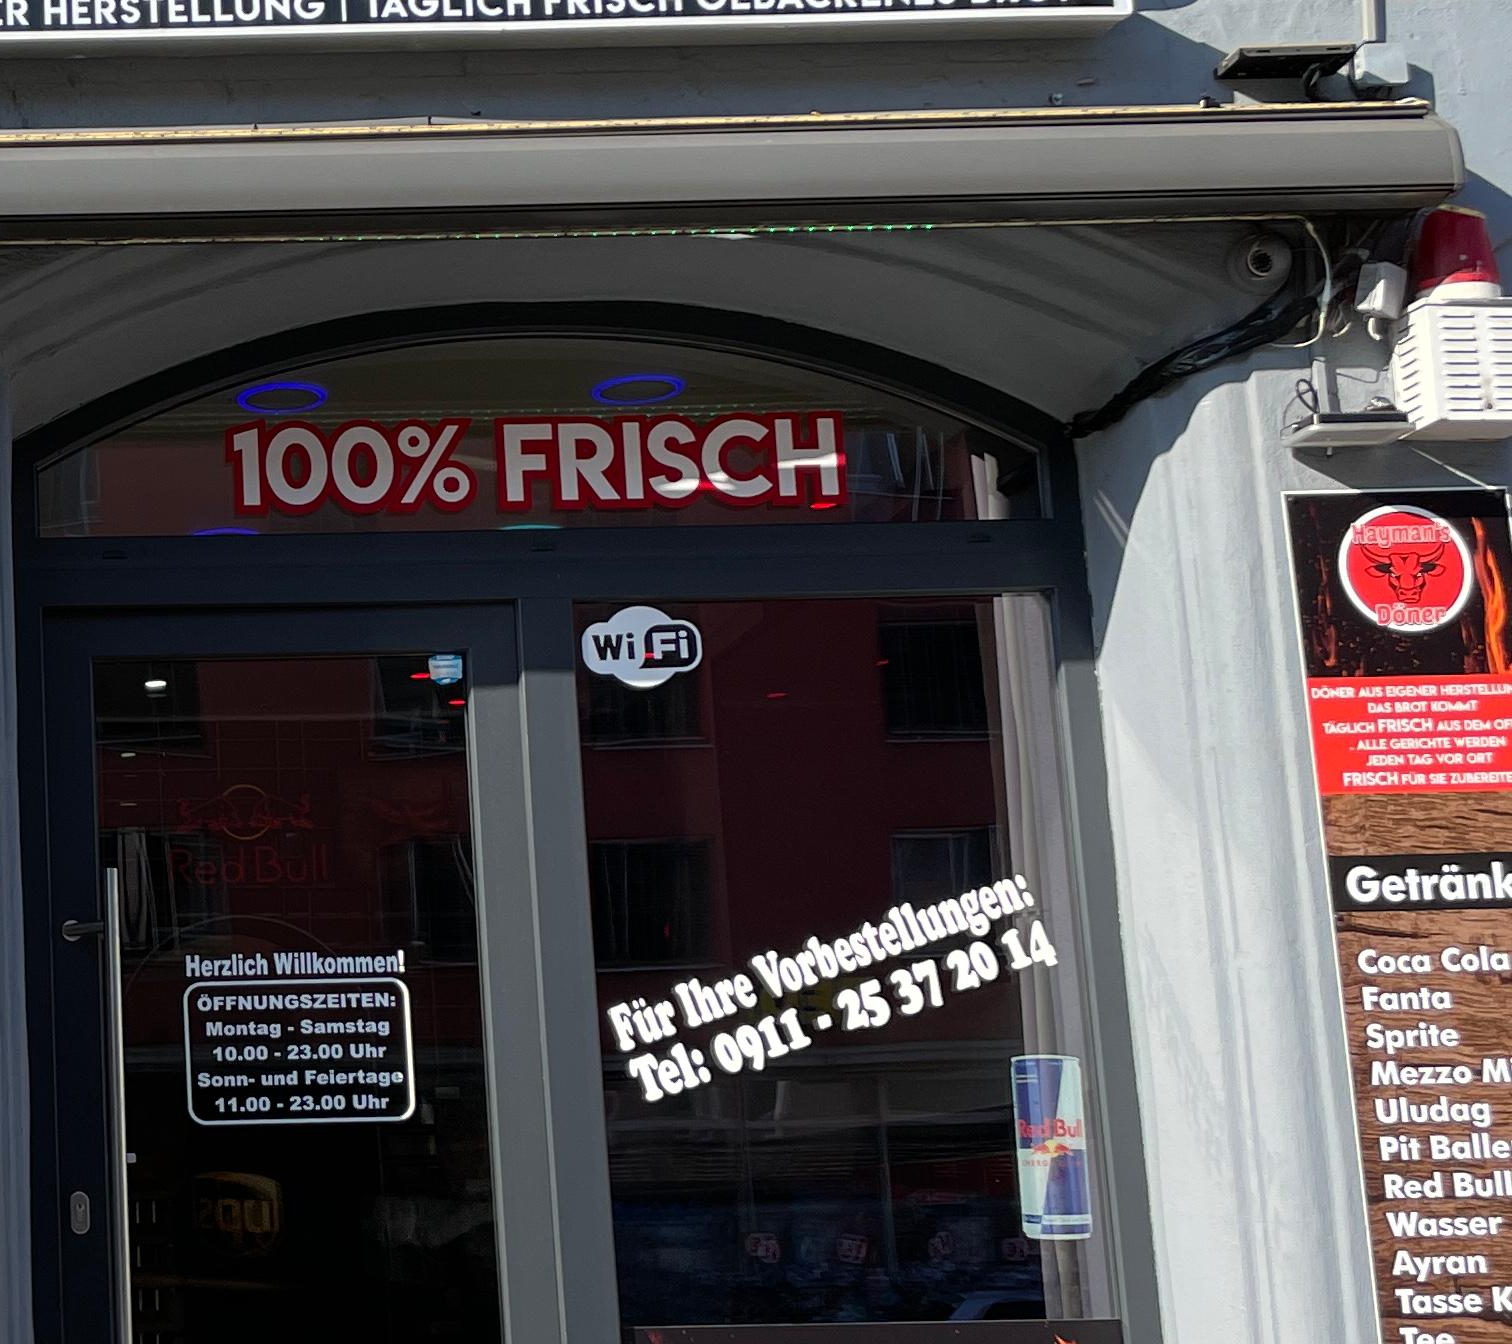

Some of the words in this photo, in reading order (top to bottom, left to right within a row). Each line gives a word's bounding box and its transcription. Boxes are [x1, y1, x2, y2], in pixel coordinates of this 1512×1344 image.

[233, 424, 472, 507] 100%
[502, 418, 841, 503] FRISCH
[1351, 522, 1451, 548] Hayman's
[1375, 603, 1447, 626] Döner
[1311, 686, 1355, 699] DÖNER
[1358, 686, 1384, 698] AUS
[1386, 684, 1437, 698] EIGENER
[1367, 702, 1392, 714] DAS
[1394, 700, 1428, 713] BROT
[1431, 699, 1478, 712] KOMMT
[1322, 720, 1375, 735] TÄGLICH
[1377, 717, 1433, 733] FRISCH
[1436, 719, 1462, 732] AUS
[1463, 719, 1492, 731] DEM
[1357, 739, 1387, 751] ALLE
[1389, 737, 1451, 750] GERICHTE
[1454, 735, 1507, 748] WERDEN
[1366, 754, 1404, 767] JEDEN
[1407, 754, 1433, 766] TAG
[1436, 752, 1464, 765] VOR
[1466, 751, 1494, 764] ORT
[1342, 771, 1399, 787] FRISCH
[1401, 772, 1427, 785] FÜR
[1429, 772, 1449, 785] SIE
[168, 847, 248, 885] Red
[255, 843, 329, 883] Bull
[185, 953, 269, 977] Herzlich
[273, 949, 406, 975] Willkommen!
[607, 997, 675, 1052] Für
[675, 967, 757, 1028] Ihre
[751, 874, 1035, 999] Vorbestellungen:
[1357, 948, 1433, 974] Coca
[1440, 945, 1512, 973] Cola
[196, 992, 397, 1012] ÖFFNUNGSZEITEN:
[627, 1043, 712, 1102] Tel:
[714, 1007, 811, 1071] 0911
[837, 980, 891, 1032] 25
[890, 959, 945, 1016] 37
[947, 940, 1000, 991] 20
[1001, 919, 1058, 972] 14
[1361, 985, 1455, 1012] Fanta
[205, 1021, 282, 1038] Montag
[299, 1019, 390, 1036] Samstag
[1365, 1021, 1462, 1055] Sprite
[212, 1045, 269, 1062] 10.00
[287, 1044, 344, 1060] 23.00
[349, 1043, 387, 1059] Uhr
[197, 1072, 256, 1087] Sonn-
[261, 1070, 298, 1086] und
[304, 1069, 404, 1087] Feiertage
[1371, 1060, 1474, 1086] Mezzo
[214, 1096, 271, 1113] 11.00
[289, 1095, 346, 1111] 23.00
[352, 1094, 390, 1110] Uhr
[1374, 1095, 1493, 1128] Uludag
[1054, 1116, 1084, 1138] Bull
[1379, 1134, 1421, 1161] Pit
[1429, 1132, 1512, 1160] Balle
[1383, 1171, 1445, 1199] Red
[1452, 1169, 1512, 1198] Bull
[1385, 1210, 1504, 1238] Wasser
[1391, 1249, 1490, 1283] Ayran
[1394, 1287, 1484, 1315] Tasse
